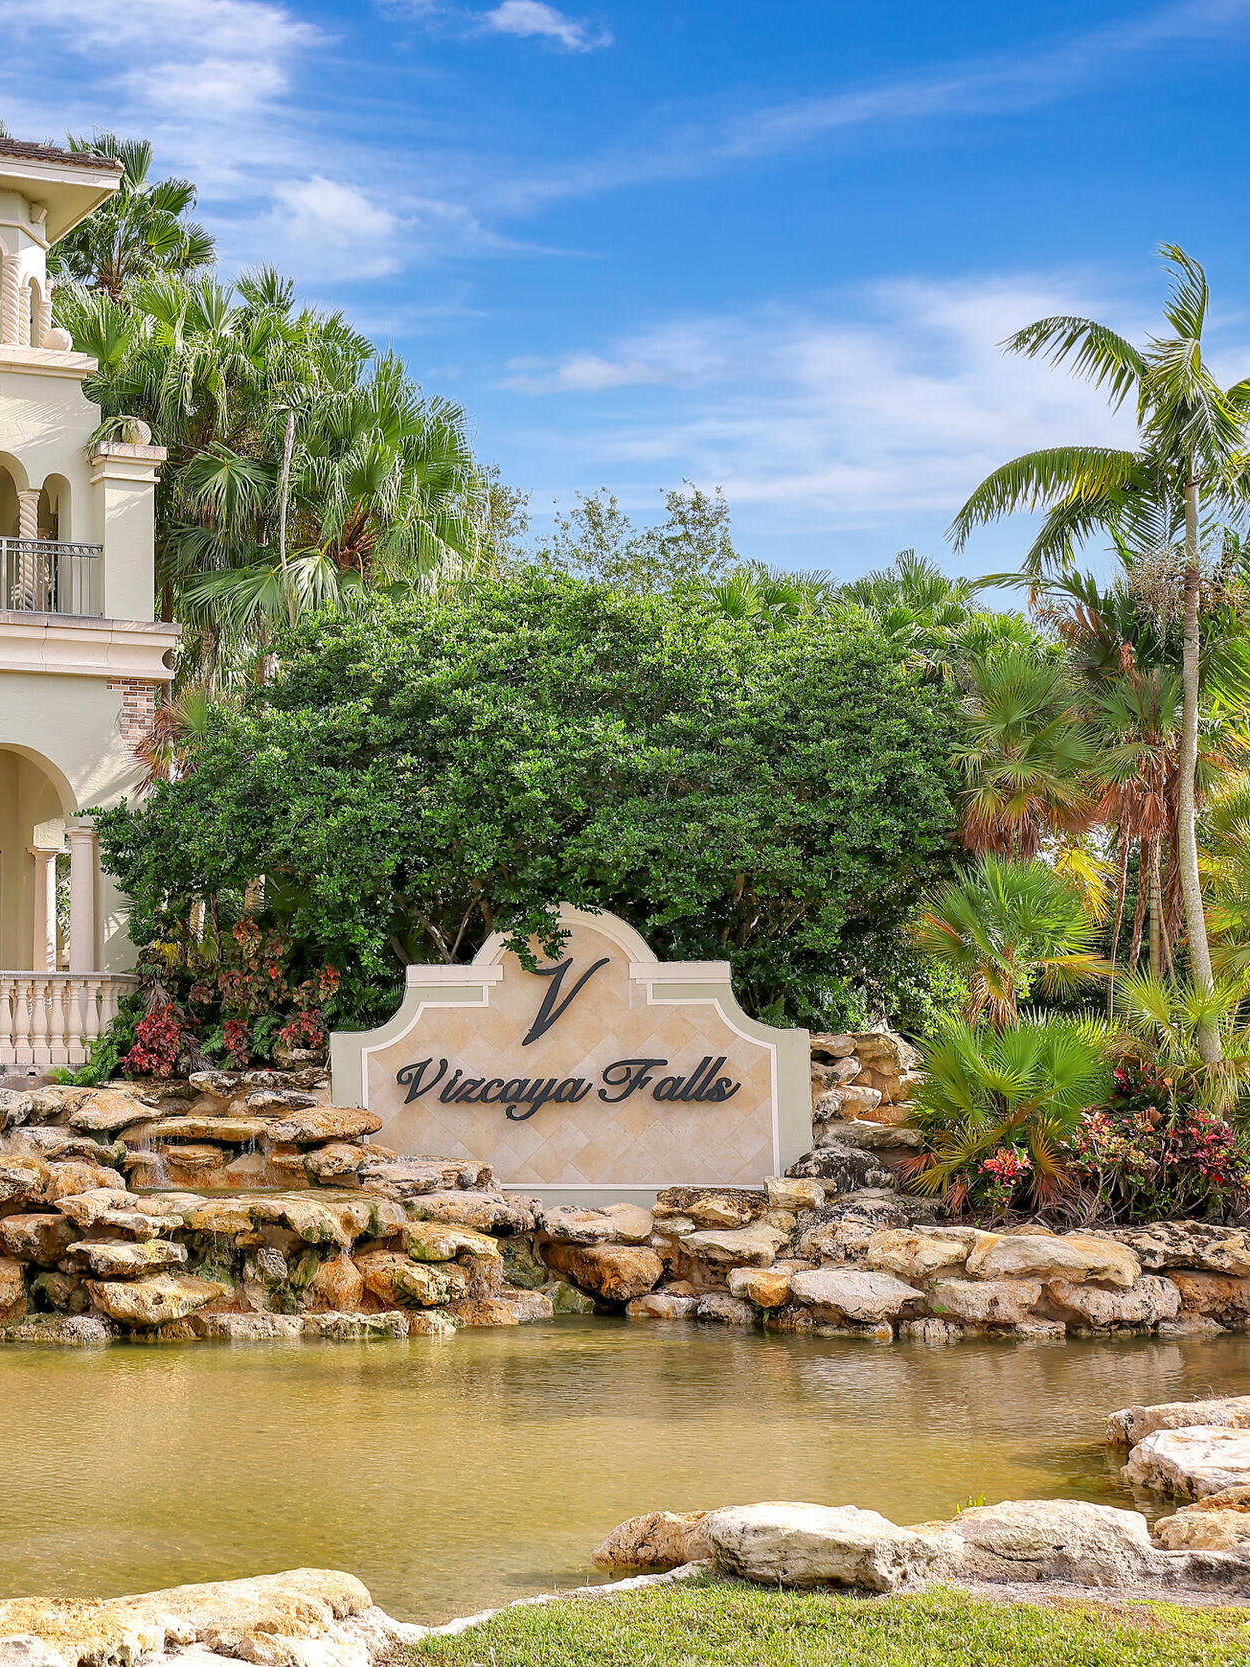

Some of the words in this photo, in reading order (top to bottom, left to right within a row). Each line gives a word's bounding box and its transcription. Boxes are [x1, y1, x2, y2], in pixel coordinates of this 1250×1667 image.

[522, 958, 610, 1046] V
[397, 1058, 592, 1121] Vizcaya
[598, 1056, 741, 1103] Falls
